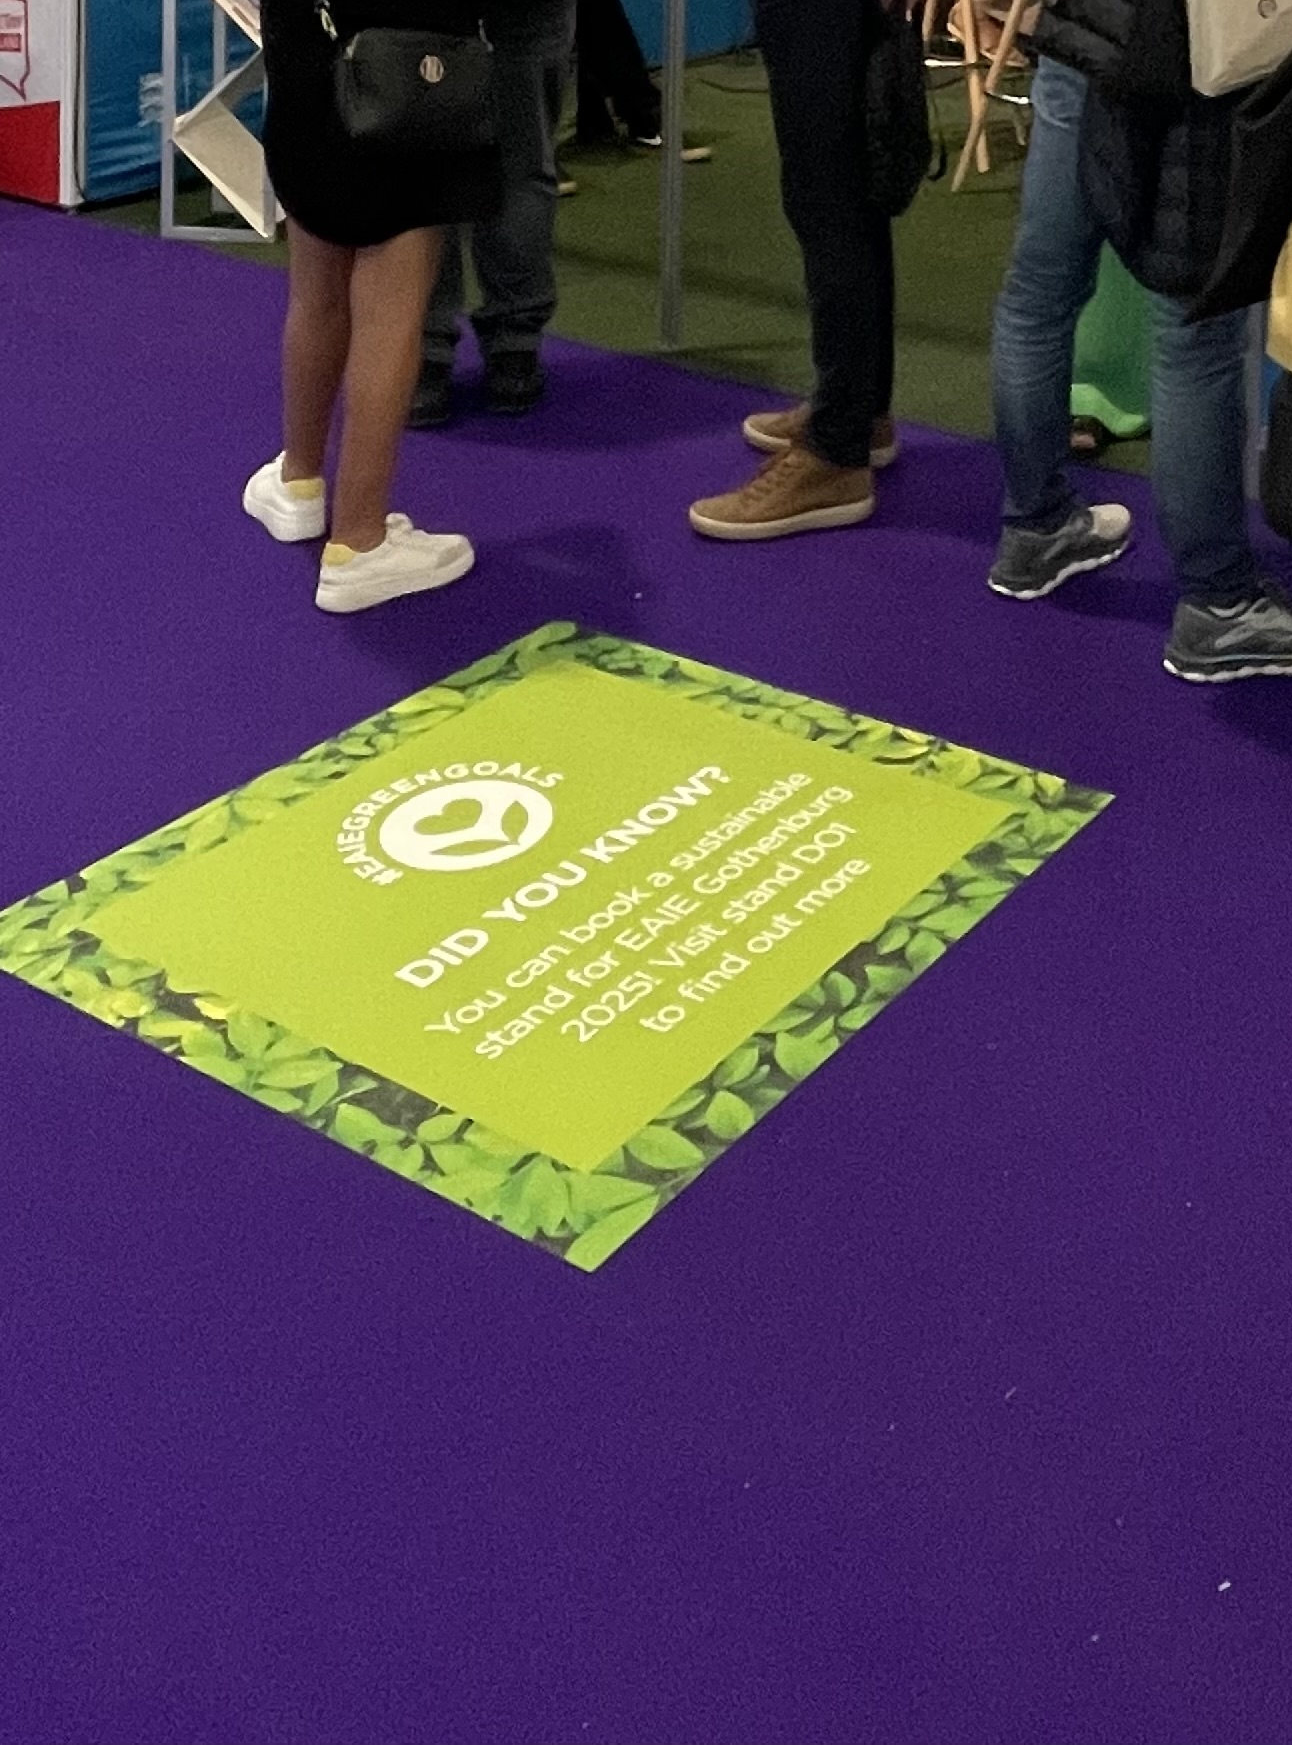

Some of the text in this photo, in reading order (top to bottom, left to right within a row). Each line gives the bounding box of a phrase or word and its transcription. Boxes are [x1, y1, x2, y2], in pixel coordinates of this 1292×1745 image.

[394, 766, 731, 988] DID YOU KNOW?
[424, 772, 815, 1034] You can book a sustainable
[475, 785, 854, 1060] stand for EAIE Gothenburg
[561, 971, 662, 1042] 2025!
[648, 923, 728, 967] Visit
[722, 862, 803, 924] stand
[639, 859, 871, 1032] to find out more
